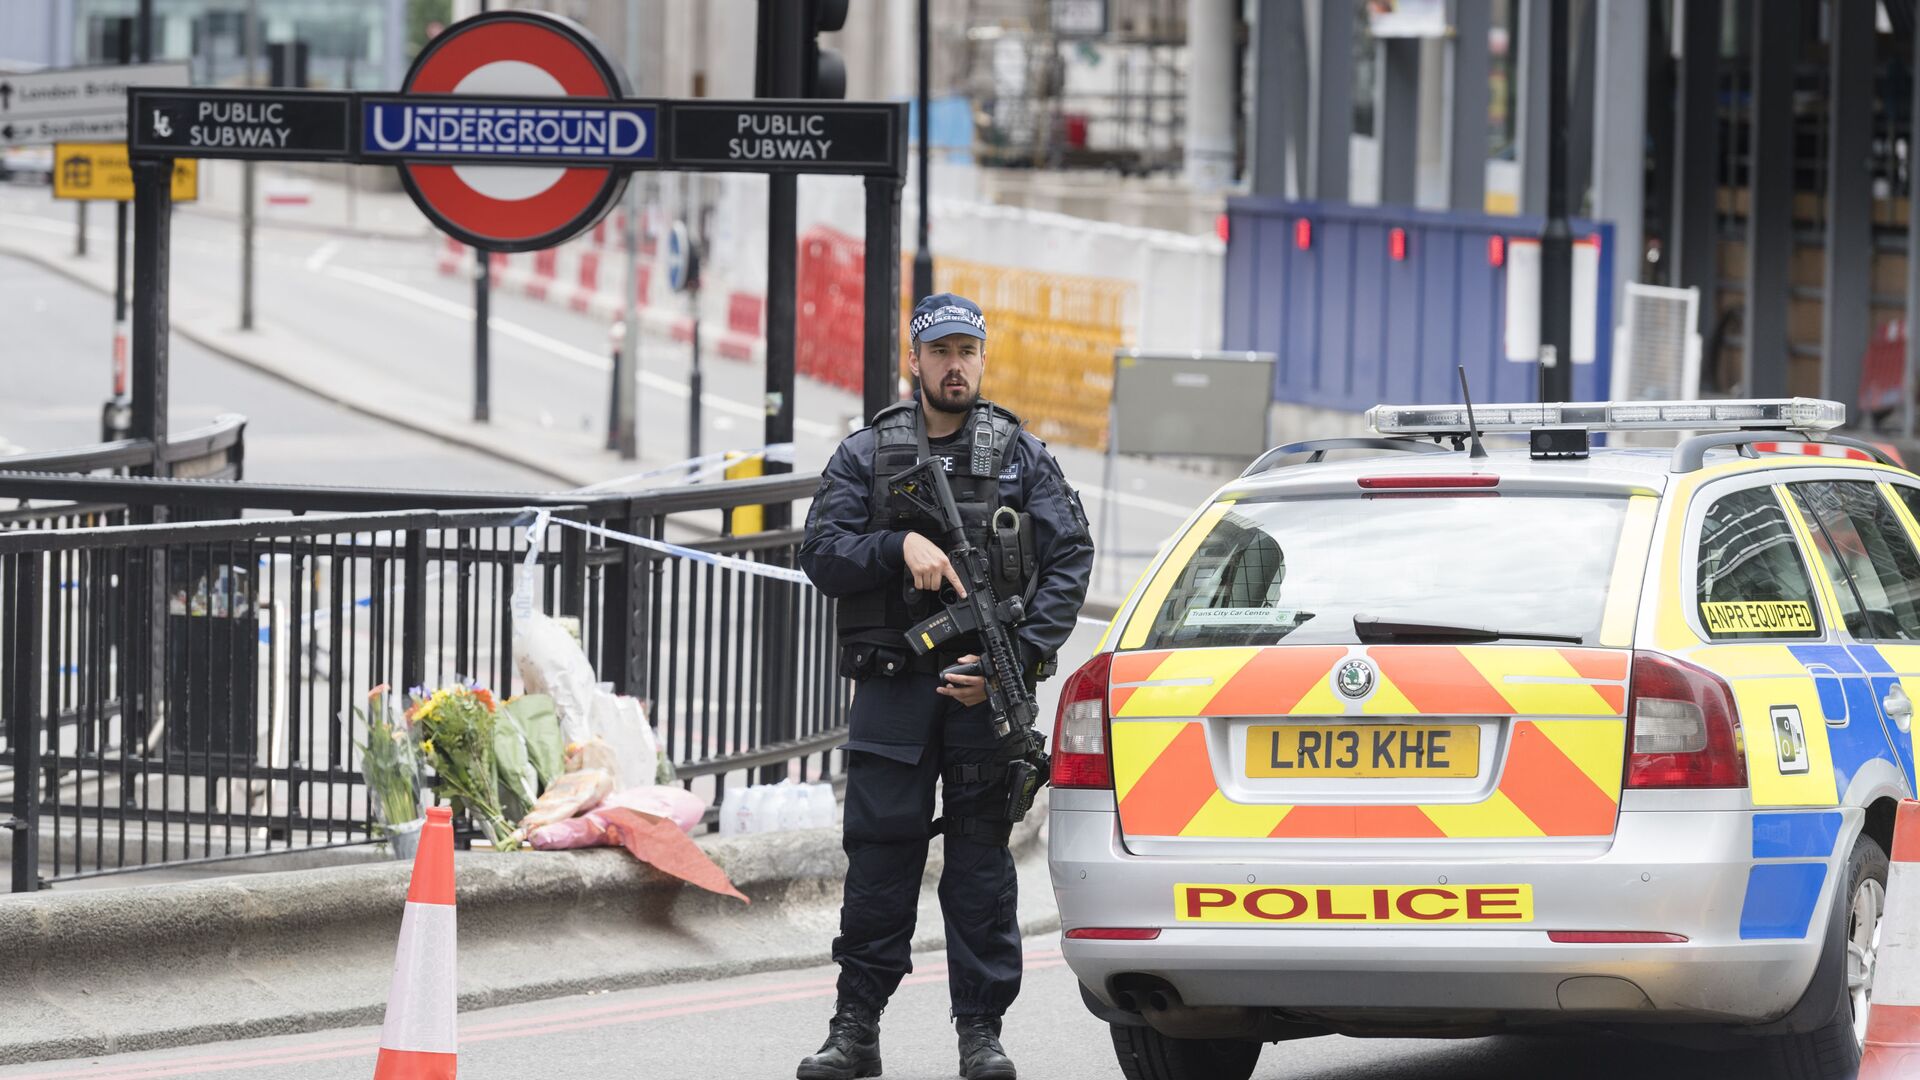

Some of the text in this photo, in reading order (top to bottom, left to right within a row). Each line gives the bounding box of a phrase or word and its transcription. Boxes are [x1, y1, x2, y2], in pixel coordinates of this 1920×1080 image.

[20, 85, 78, 101] London
[199, 102, 284, 124] PUBLIC
[373, 106, 647, 155] UNDERGROUND
[738, 114, 824, 135] PUBLIC
[190, 126, 291, 147] SUBWAY
[729, 138, 832, 159] SUBWAY
[1707, 604, 1812, 629] ANPR EQUIPPED
[1271, 731, 1451, 768] LR13 KHE
[1186, 887, 1523, 921] POLICE
